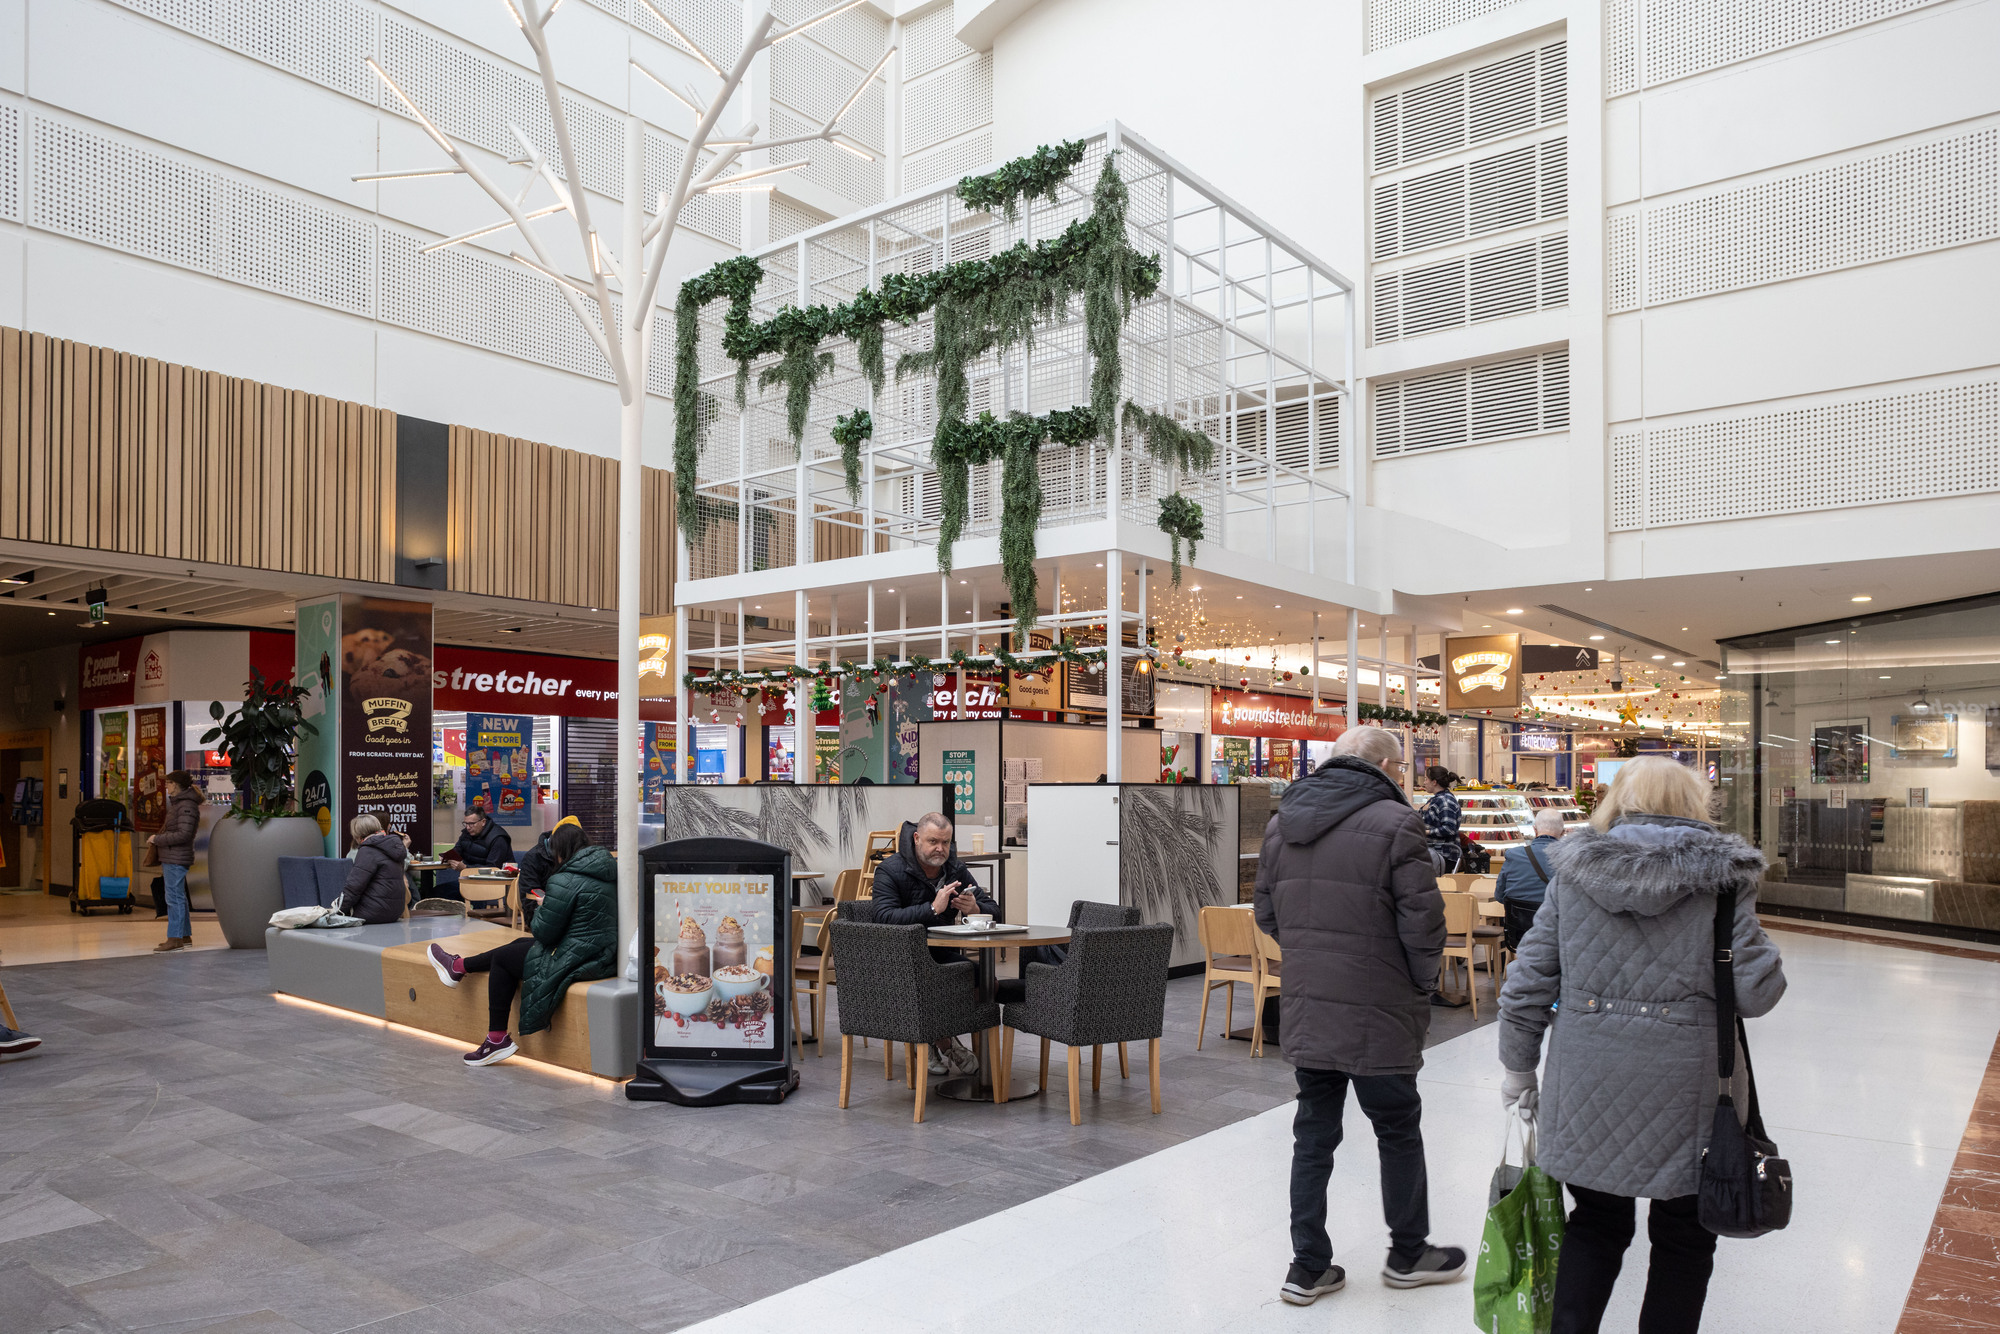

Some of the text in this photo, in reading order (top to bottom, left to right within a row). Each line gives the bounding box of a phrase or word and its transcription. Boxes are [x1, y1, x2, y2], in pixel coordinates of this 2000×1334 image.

[638, 636, 667, 646] UFFIN
[1030, 637, 1052, 649] FFIN
[94, 650, 120, 674] pound
[1458, 653, 1505, 667] MUFFIN
[91, 667, 131, 688] stretcher
[433, 666, 573, 697] stretcher
[1463, 675, 1501, 687] BREAK
[575, 689, 601, 701] every
[1019, 685, 1032, 694] Good
[1032, 687, 1043, 695] goes
[368, 699, 407, 710] MUFFIN
[1234, 706, 1318, 727] poundstretcher
[372, 718, 403, 728] BREAK
[482, 717, 519, 731] NEW
[141, 724, 158, 738] BITES
[365, 734, 385, 743] Good
[385, 737, 403, 746] goes
[480, 736, 519, 744] IN-STORE
[901, 731, 918, 744] KID
[949, 751, 968, 759] STOP!
[1229, 749, 1248, 757] Everyone
[1273, 748, 1289, 756] TREATS
[356, 771, 418, 784] From freshly baked
[358, 783, 376, 791] cakes
[384, 781, 418, 790] handmade
[305, 783, 326, 802] 24/7
[384, 790, 396, 798] and
[397, 791, 419, 799] wraps,
[358, 803, 417, 813] FIND YOUR
[662, 882, 702, 894] TREAT
[705, 882, 741, 894] YOUR
